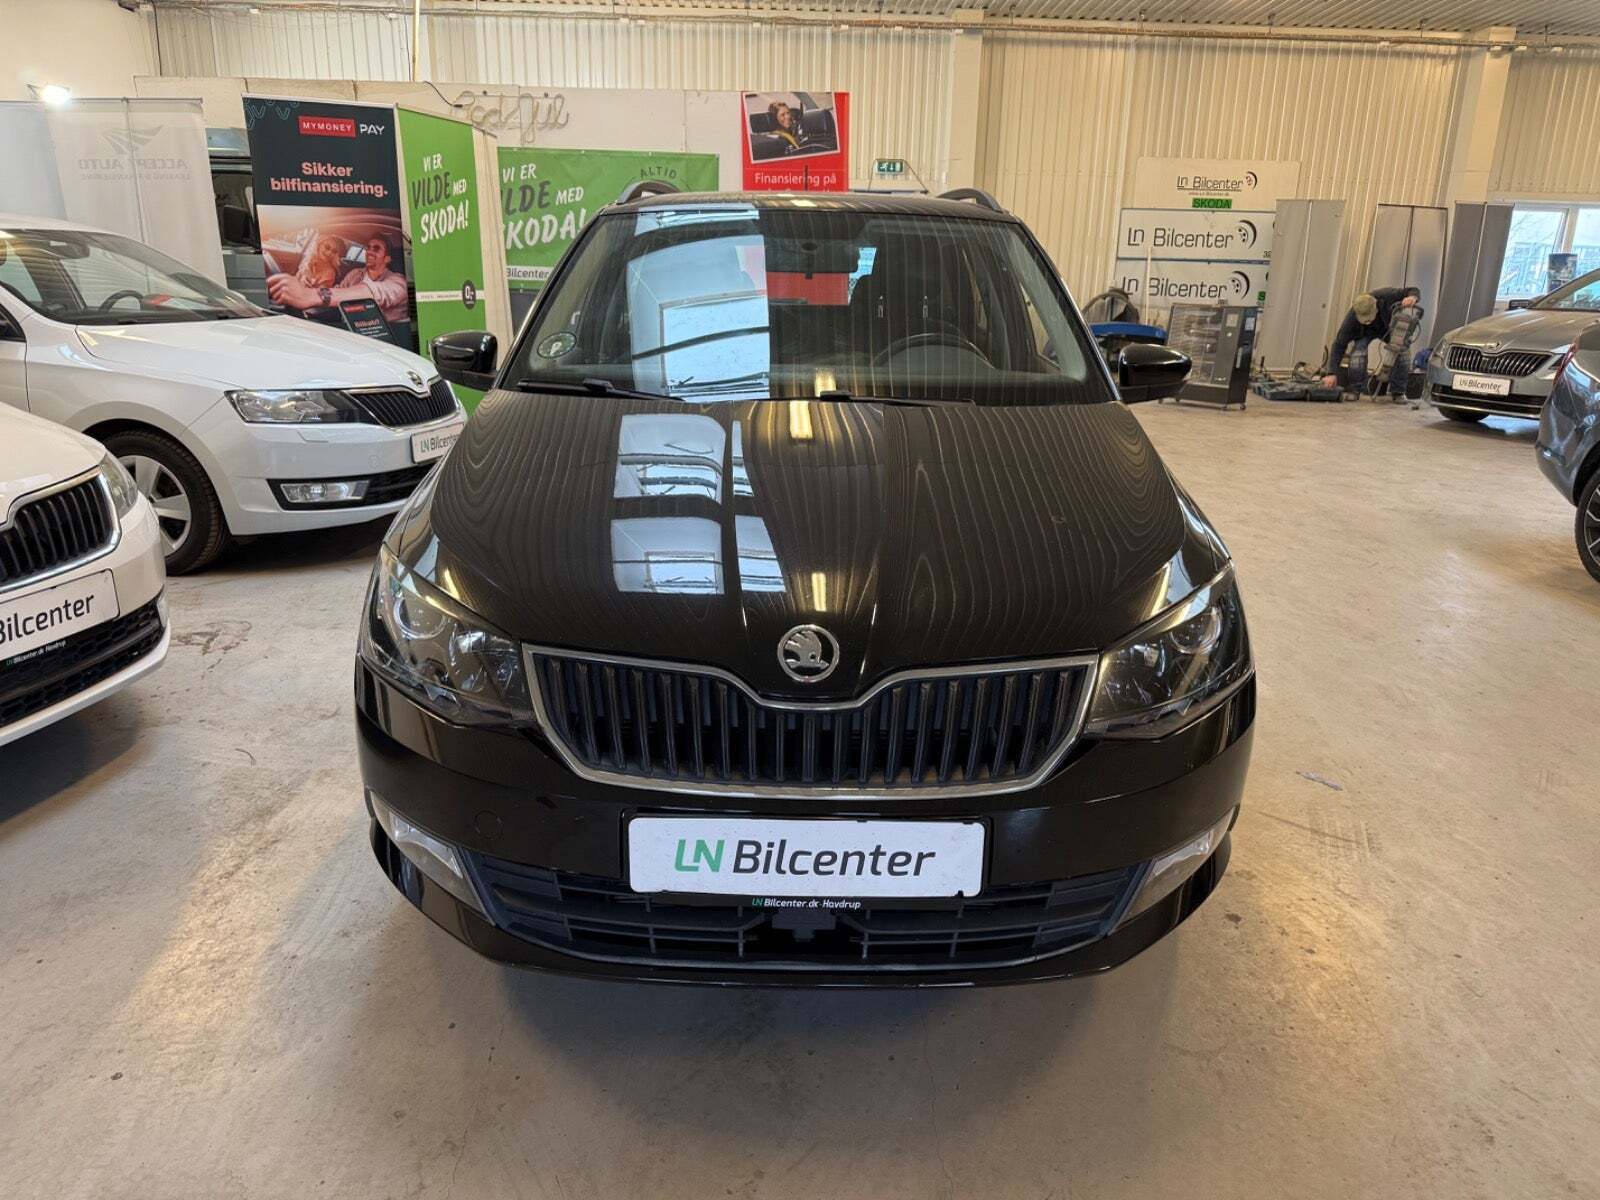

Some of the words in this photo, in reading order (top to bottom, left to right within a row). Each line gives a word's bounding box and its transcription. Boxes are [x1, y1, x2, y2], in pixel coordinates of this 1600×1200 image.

[302, 121, 352, 132] MYMONEY
[359, 123, 385, 135] PAY
[301, 161, 353, 176] Sikker
[423, 156, 431, 173] VI
[432, 152, 443, 170] ER
[640, 166, 677, 179] ALTID
[502, 166, 515, 183] VI
[520, 163, 537, 180] ER
[754, 172, 820, 186] Finansiering
[822, 173, 837, 186] på
[1193, 176, 1243, 189] Bilcenter
[270, 177, 388, 198] bilfinansiering.
[411, 171, 450, 210] VILDE
[452, 178, 467, 196] MED
[555, 186, 584, 206] MED
[420, 199, 470, 244] SKODA!
[502, 208, 587, 251] KODA!
[1153, 227, 1234, 249] Bilcenter
[1148, 277, 1228, 298] Bilcenter
[1468, 379, 1502, 391] Bilcenter
[674, 839, 725, 873] LN
[732, 839, 936, 877] Bilcenter
[763, 898, 819, 908] Bilcenter.dk
[822, 899, 861, 910] Havdrup
